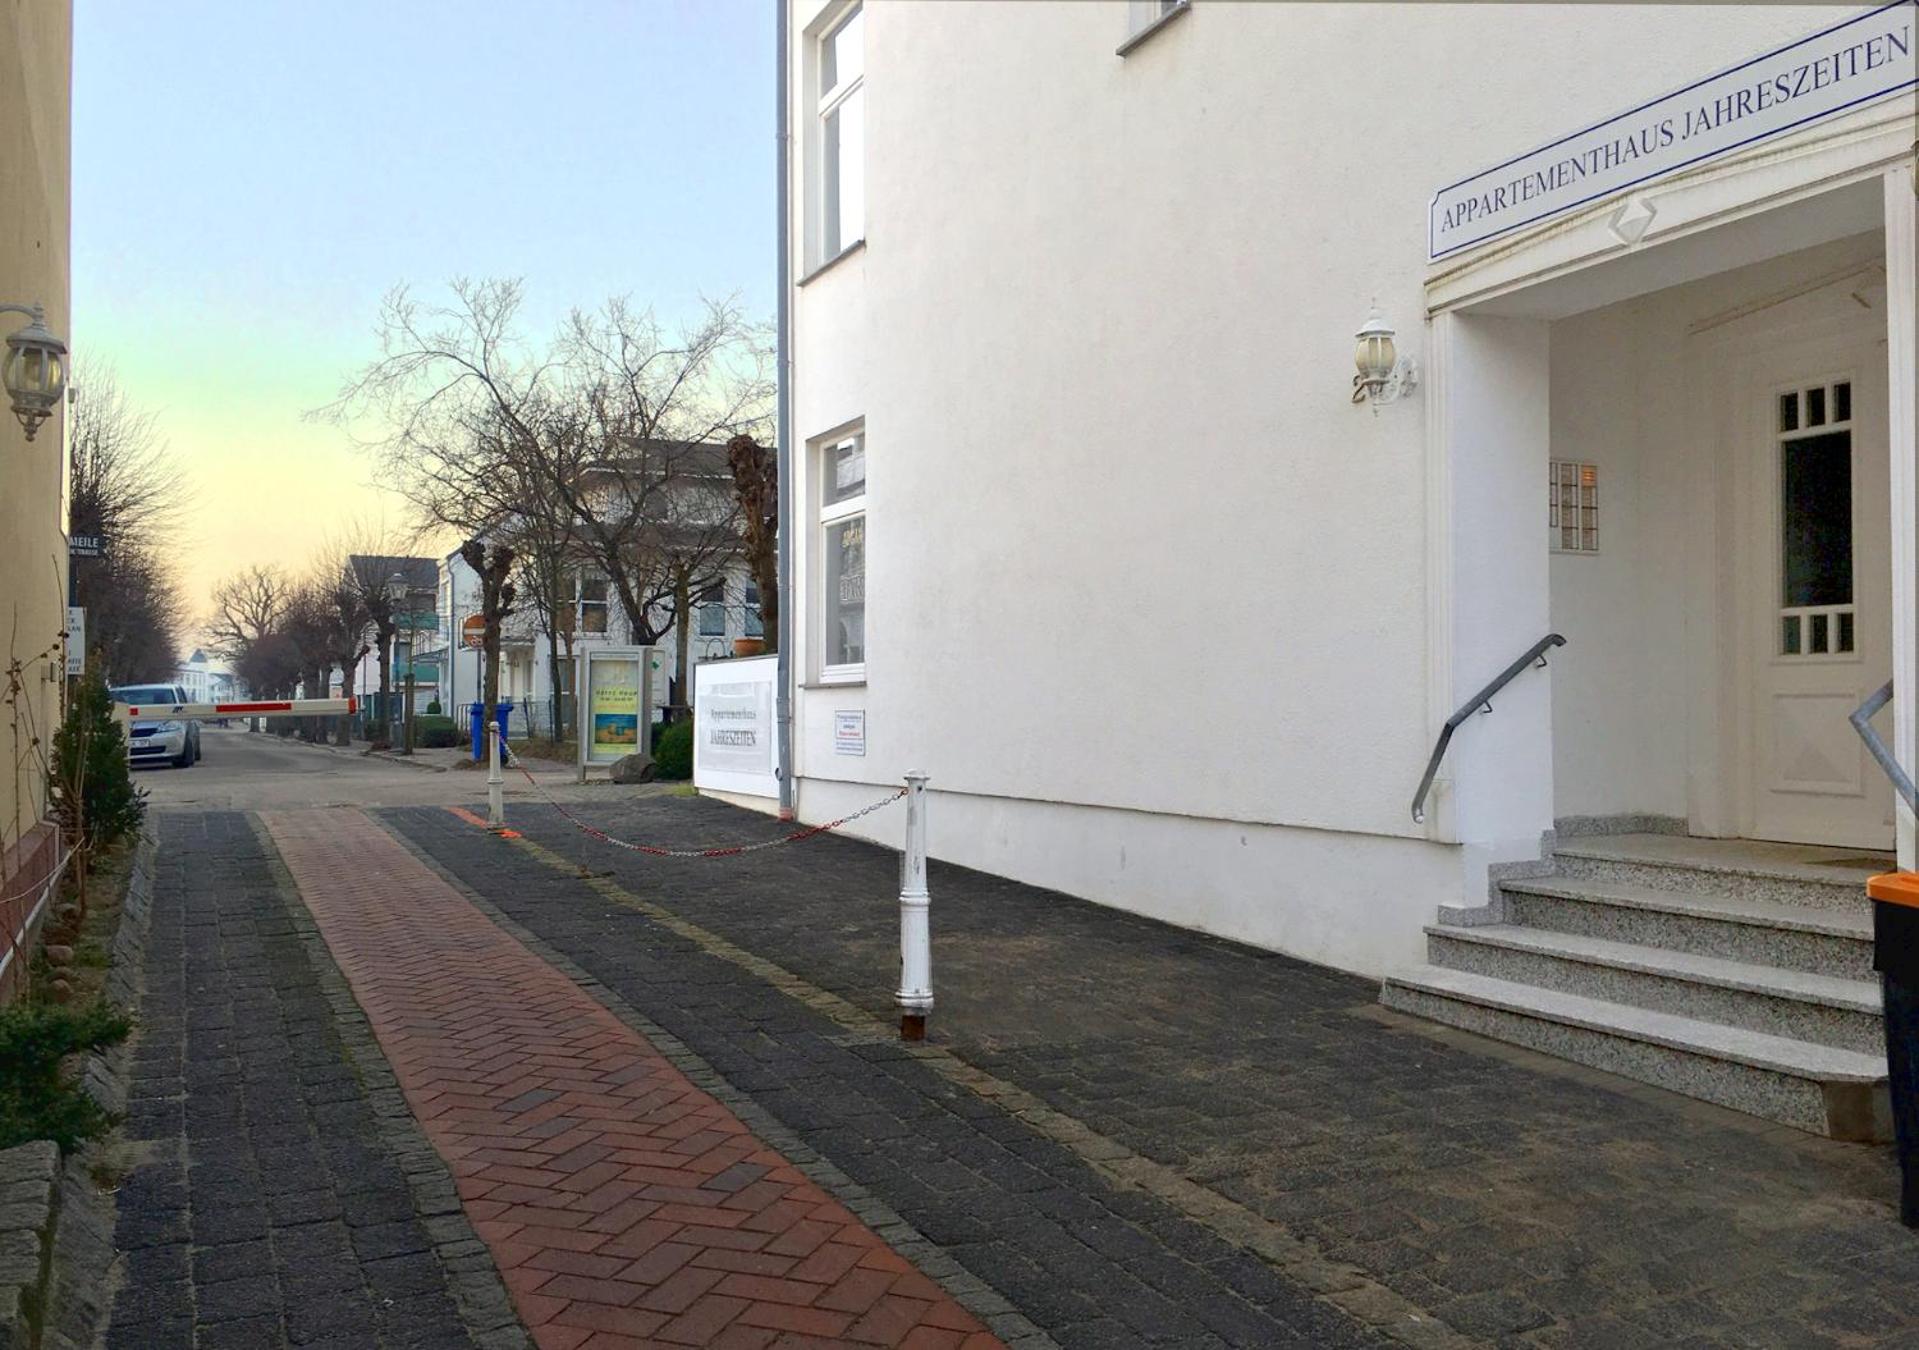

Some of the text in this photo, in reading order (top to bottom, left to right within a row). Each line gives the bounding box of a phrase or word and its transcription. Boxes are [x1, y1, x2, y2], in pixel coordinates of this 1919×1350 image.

[1441, 26, 1911, 233] APPARTEMENTHAUS JAHRESZEITEN
[710, 729, 757, 747] JAHRESZEITEN
